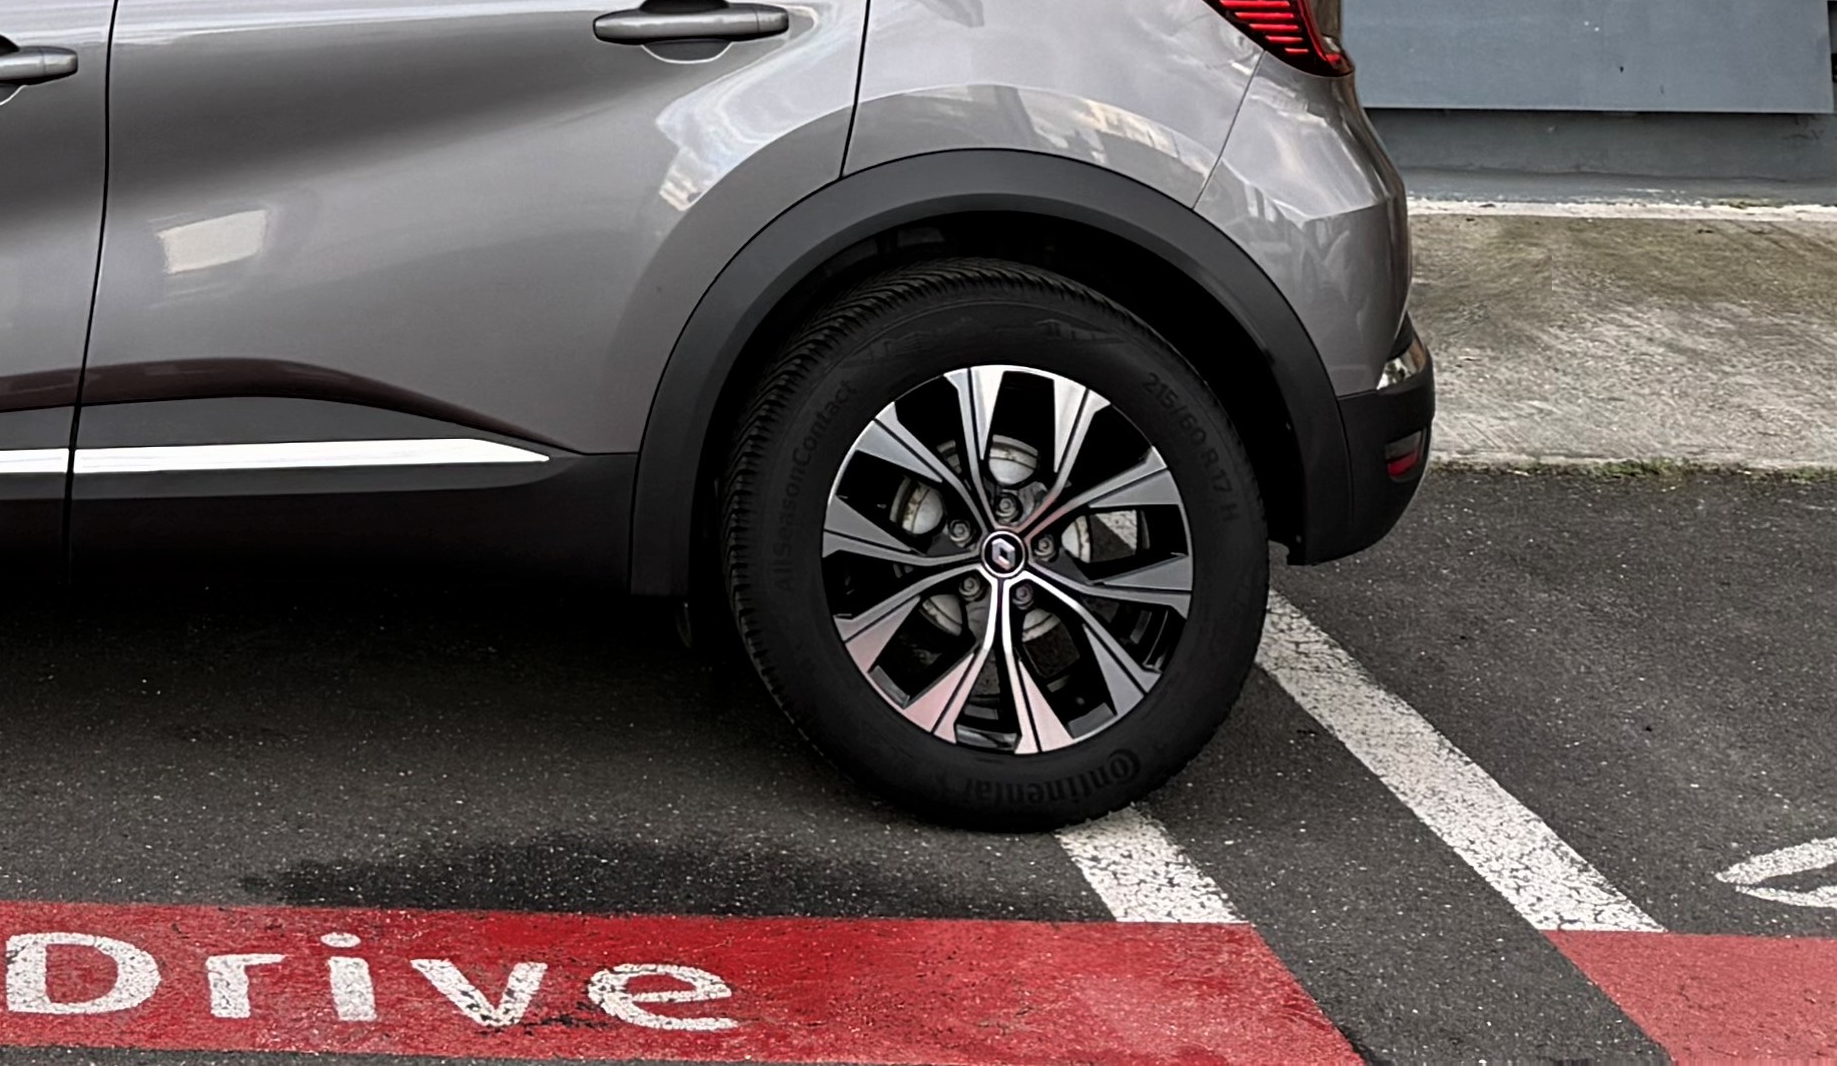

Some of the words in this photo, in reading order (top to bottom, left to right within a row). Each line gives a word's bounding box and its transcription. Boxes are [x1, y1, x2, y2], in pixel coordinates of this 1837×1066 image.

[1140, 370, 1207, 447] 215/60
[769, 379, 859, 593] AllSeasonContact
[1197, 444, 1222, 468] R
[1205, 468, 1232, 495] 17
[962, 747, 1142, 806] Continental
[5, 931, 739, 1032] Drive
